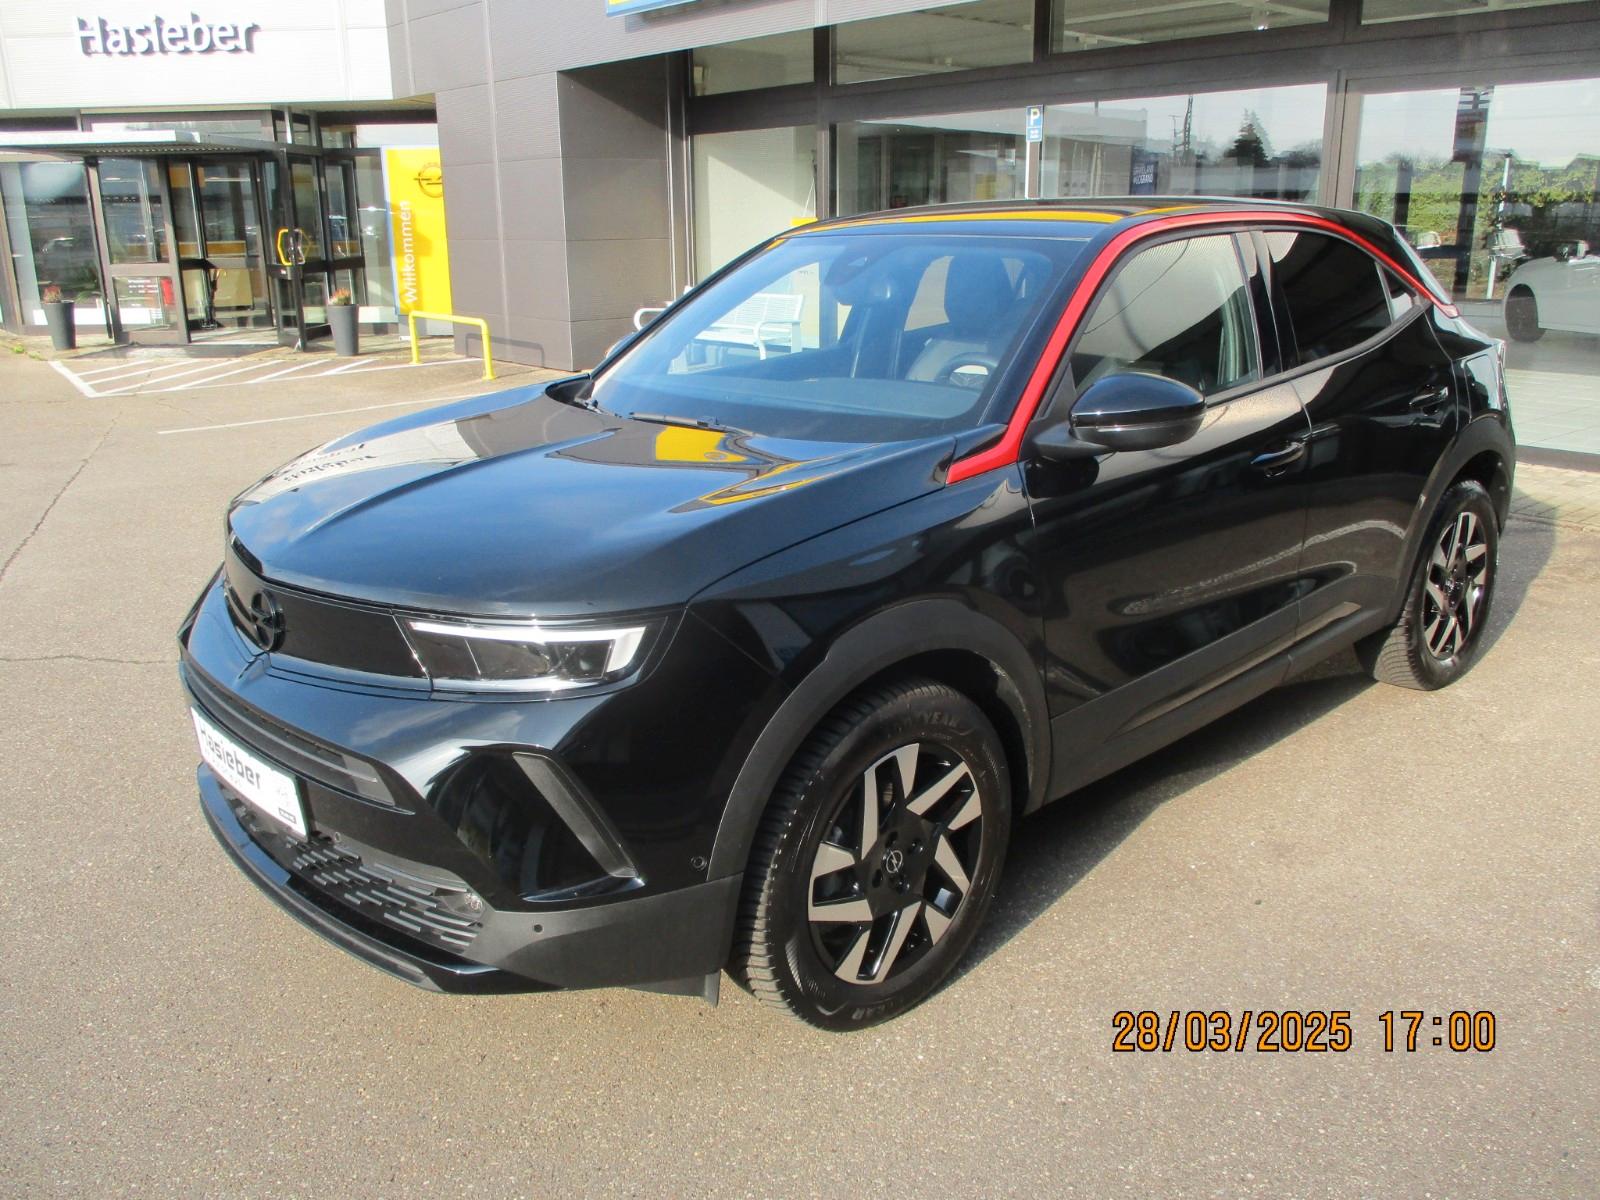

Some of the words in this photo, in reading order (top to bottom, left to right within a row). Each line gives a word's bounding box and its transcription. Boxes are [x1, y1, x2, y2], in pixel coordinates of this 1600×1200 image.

[75, 10, 262, 57] Hasleber
[1030, 108, 1041, 126] P
[399, 200, 418, 304] Willkommen
